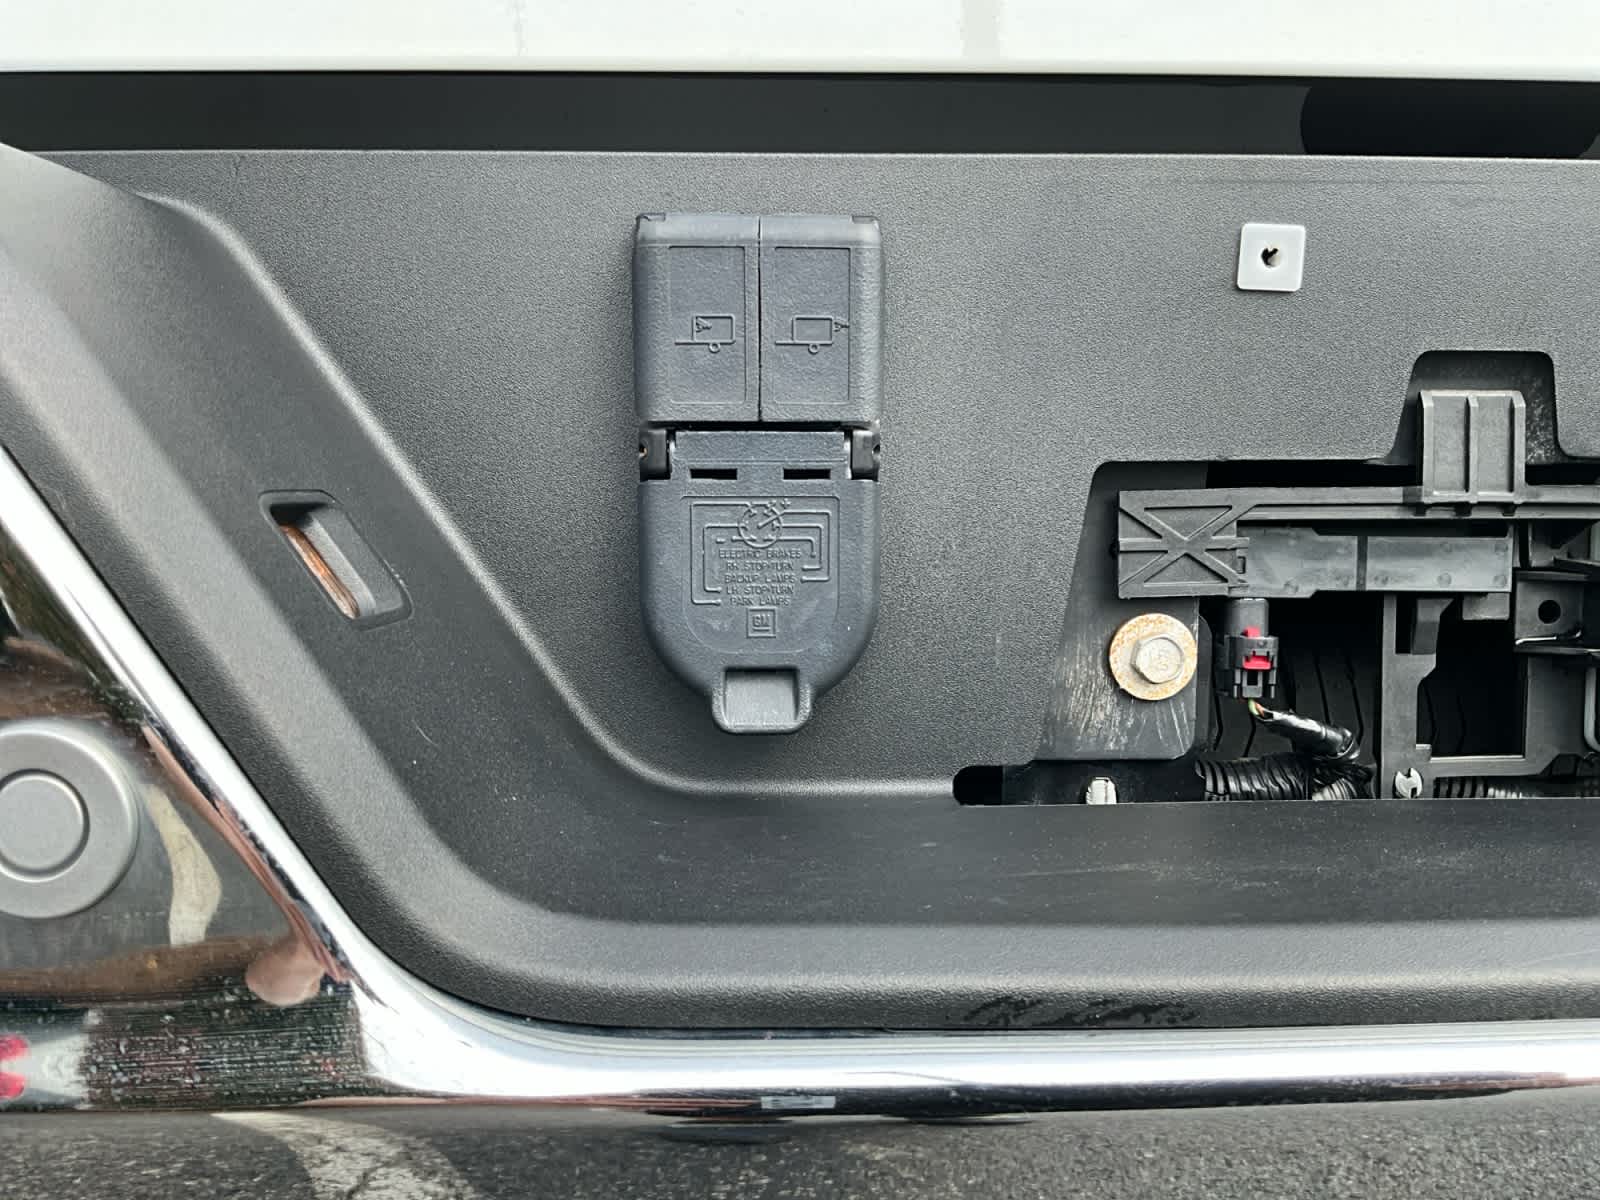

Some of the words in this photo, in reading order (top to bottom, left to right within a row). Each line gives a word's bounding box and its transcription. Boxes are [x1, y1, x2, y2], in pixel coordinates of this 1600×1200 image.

[719, 548, 761, 559] ELECTRIC
[767, 548, 801, 559] BRAKES
[724, 572, 760, 583] BACKUP
[765, 572, 796, 584] LAMPS
[730, 595, 755, 606] PARK
[759, 595, 791, 606] LAMPS
[752, 614, 771, 627] GM
